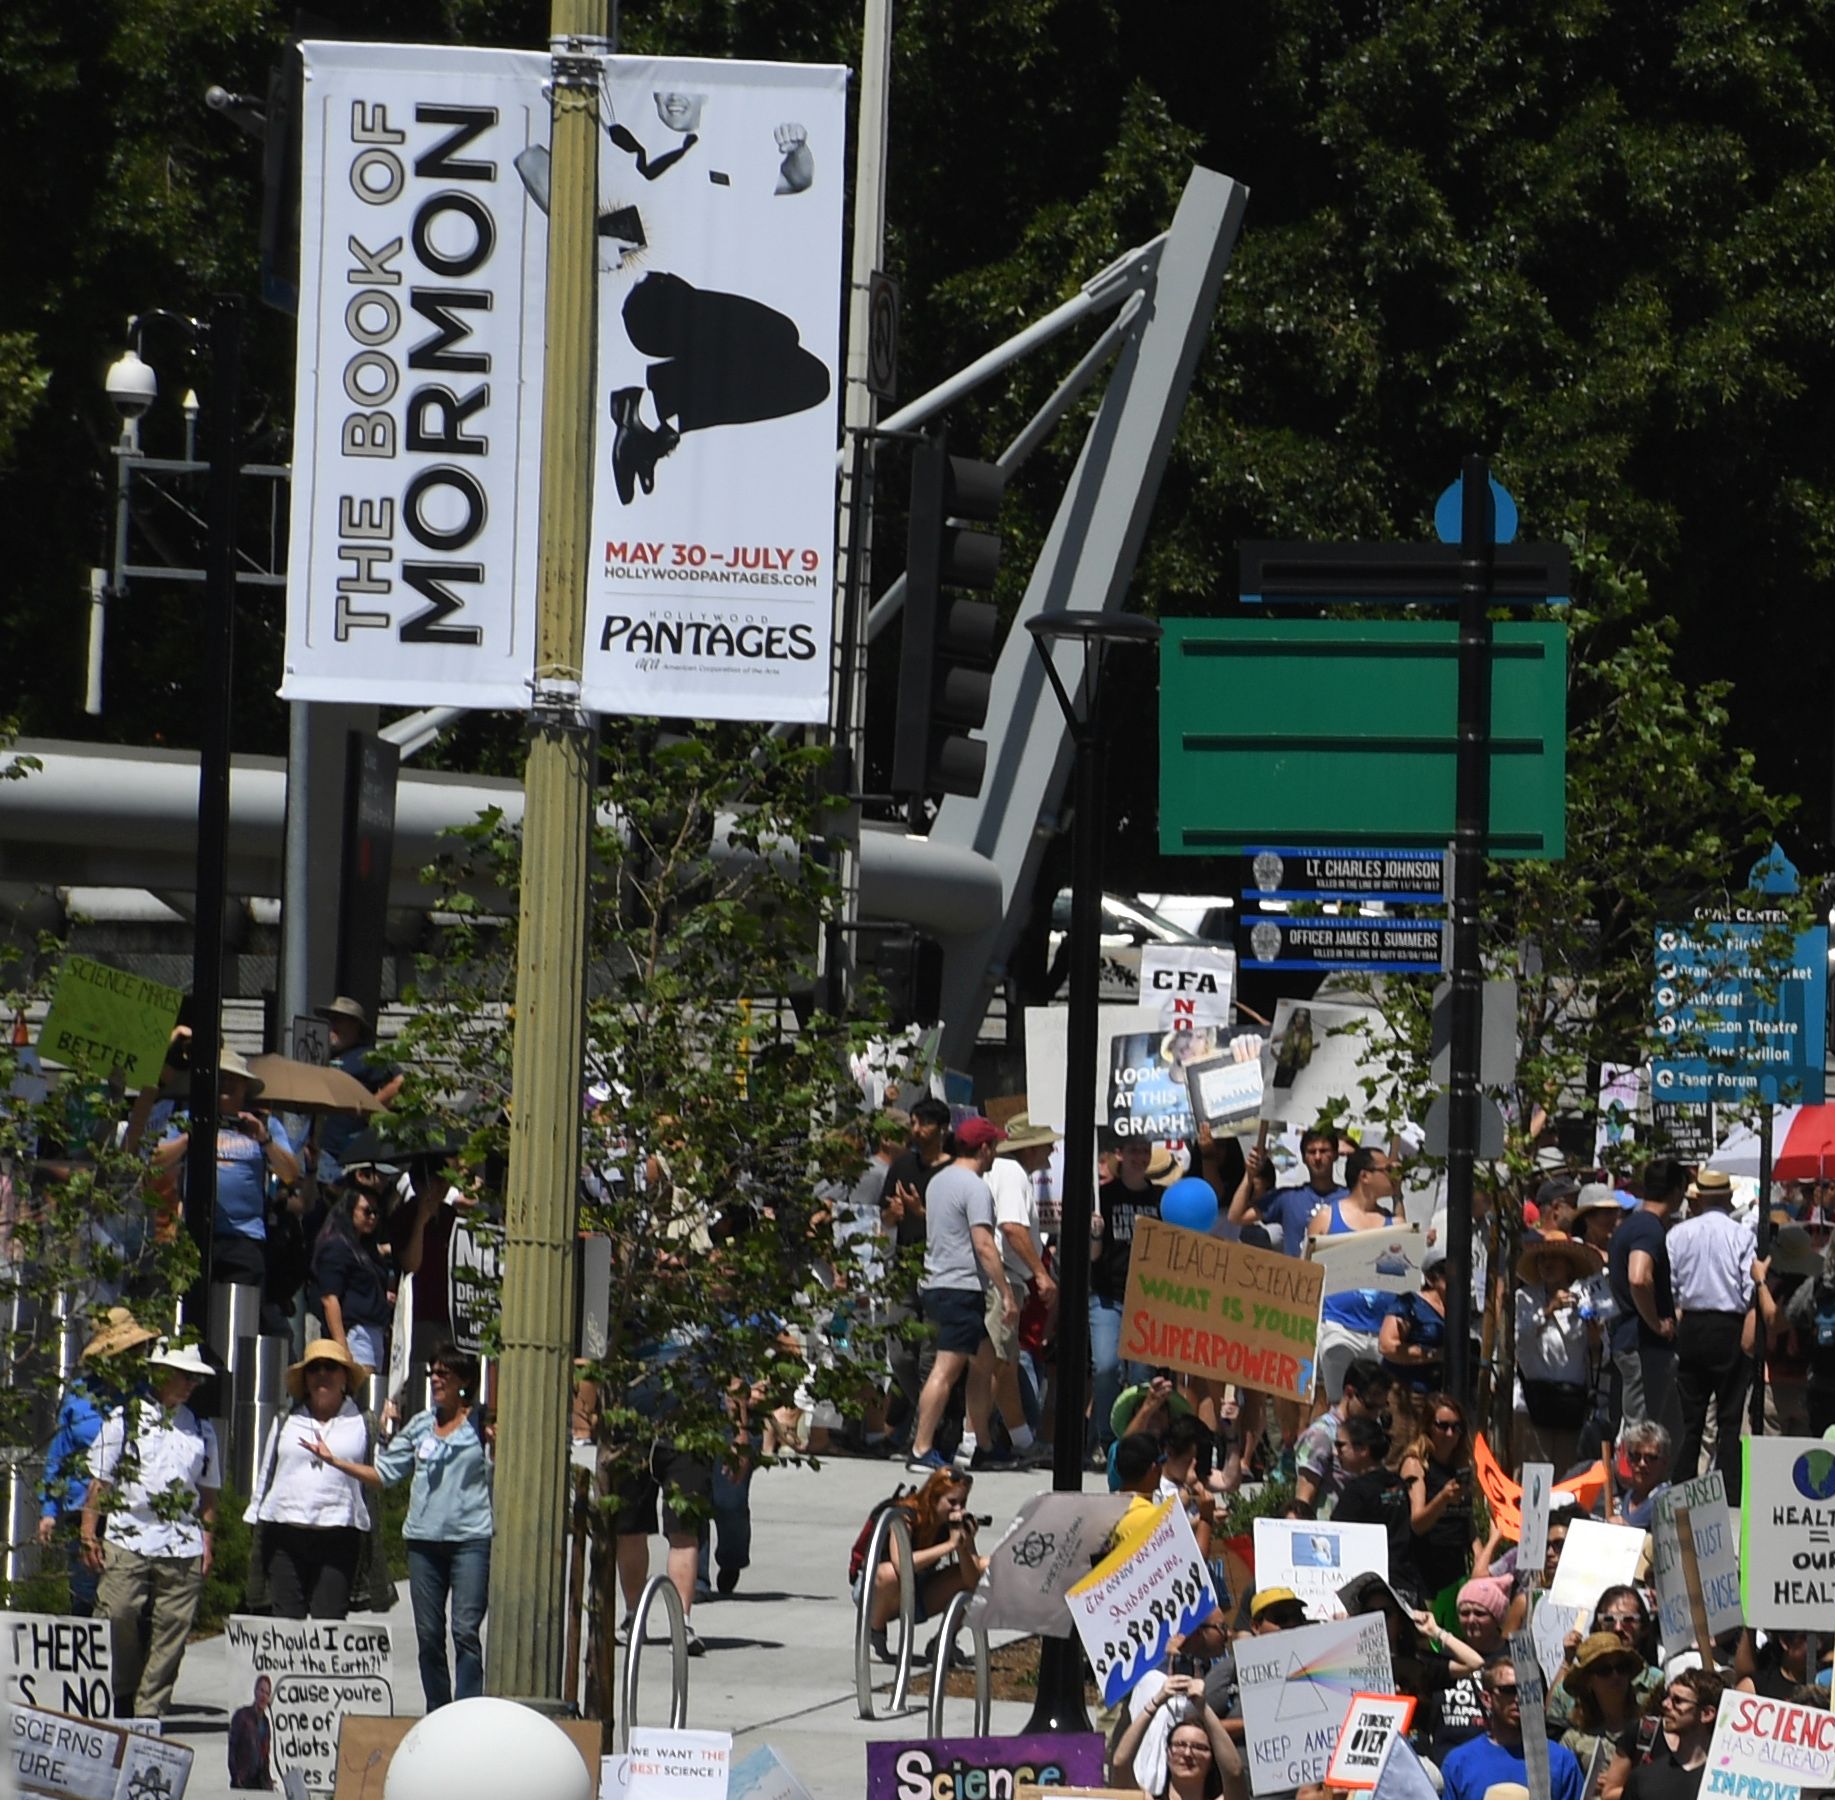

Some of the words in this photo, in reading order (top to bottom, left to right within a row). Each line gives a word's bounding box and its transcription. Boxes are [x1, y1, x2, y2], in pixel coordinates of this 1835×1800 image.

[351, 99, 407, 205] OF
[342, 234, 404, 459] BOOK
[399, 104, 499, 646] MORMON
[334, 495, 395, 641] THE
[605, 541, 664, 564] MAY
[801, 549, 819, 571] 9
[604, 566, 817, 587] HOLLYWOODPANTAGES.COM
[650, 611, 769, 624] HOLLYWOOD
[600, 615, 816, 660] PANTAGES
[1306, 860, 1322, 877] LT.
[1325, 860, 1381, 878] CHARLES
[1384, 862, 1440, 879] JOHNSON
[1290, 929, 1333, 945] OFFICER
[1335, 931, 1369, 946] JAMES
[1384, 932, 1438, 948] SUMMERS
[1152, 969, 1218, 993] CFA
[1114, 1068, 1165, 1084] LOOK
[1113, 1092, 1134, 1108] AT
[1140, 1091, 1177, 1104] THIS
[1114, 1115, 1185, 1136] GRAPH
[1138, 1226, 1158, 1262] I
[1164, 1231, 1230, 1284] TEACH
[1137, 1274, 1211, 1313] WHAT
[1222, 1296, 1244, 1323] IS
[1253, 1304, 1316, 1345] YOUR
[1127, 1310, 1314, 1396] SUPERPOWER?
[227, 1623, 258, 1663] Why
[262, 1625, 320, 1651] should
[323, 1626, 339, 1650] I
[343, 1633, 390, 1651] care
[255, 1654, 295, 1672] about
[300, 1654, 326, 1673] the
